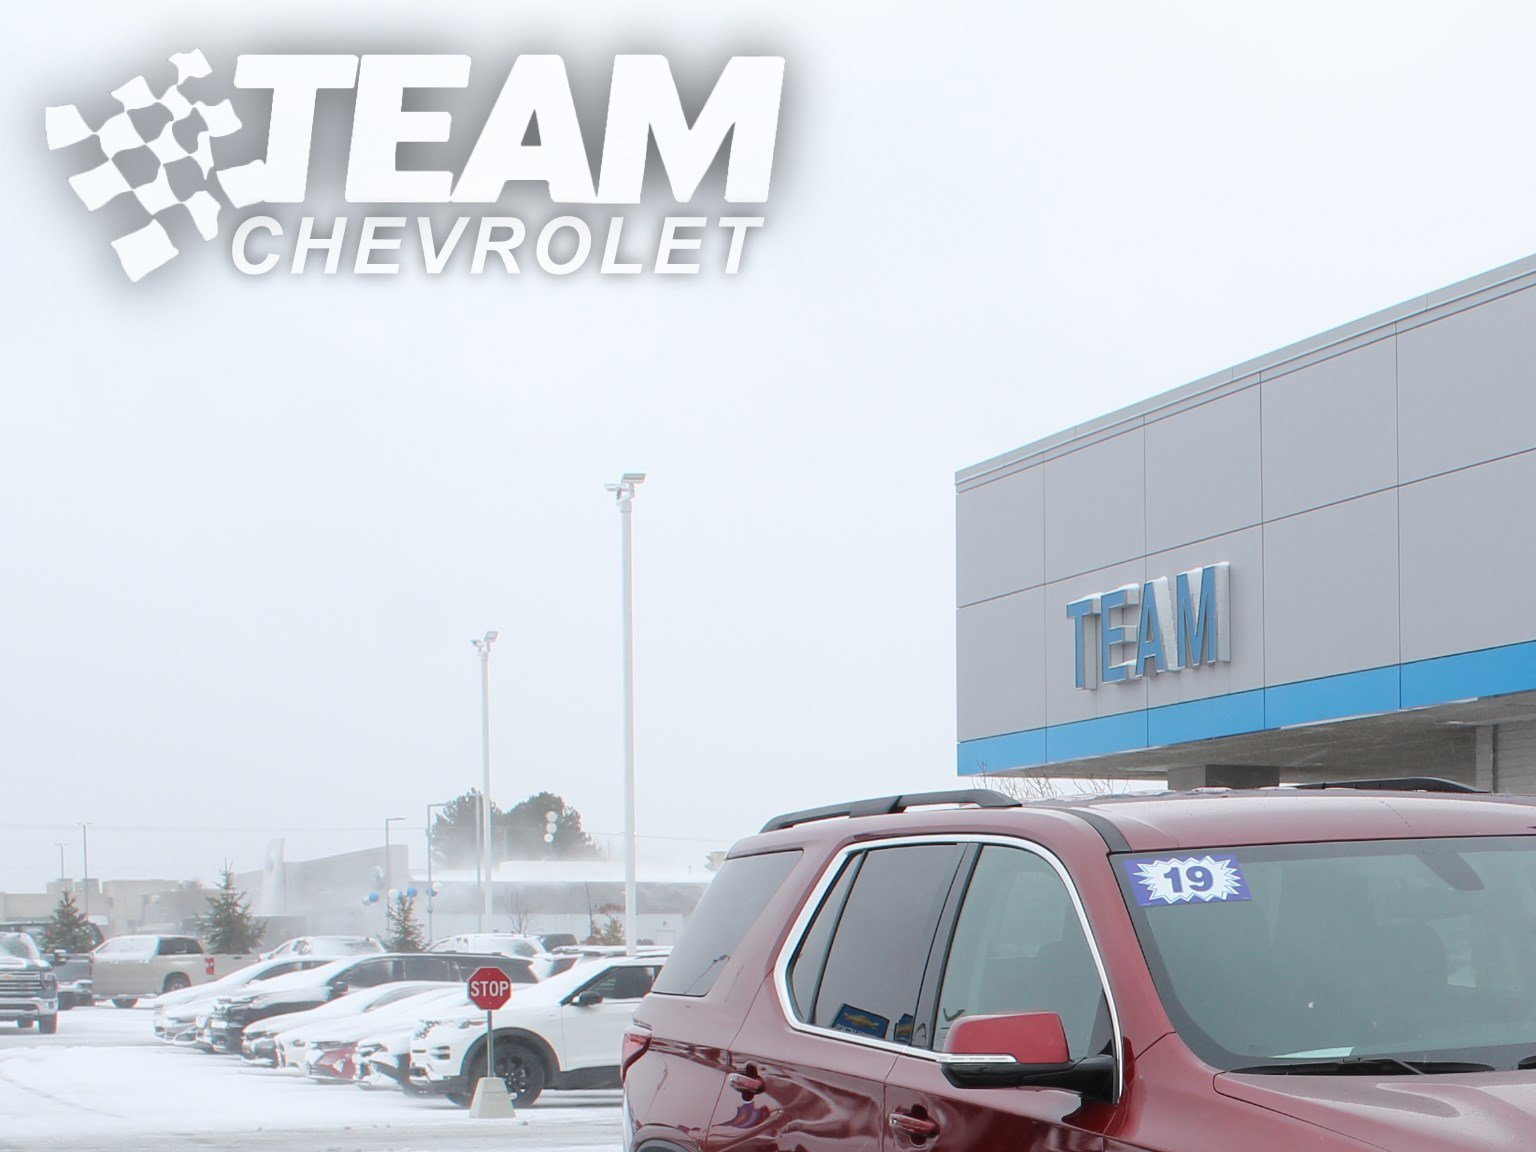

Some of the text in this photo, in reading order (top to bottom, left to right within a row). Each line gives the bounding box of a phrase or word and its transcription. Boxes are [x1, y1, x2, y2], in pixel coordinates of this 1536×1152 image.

[1066, 562, 1232, 690] TEAM
[1163, 866, 1215, 893] 19
[470, 980, 509, 997] STOP
